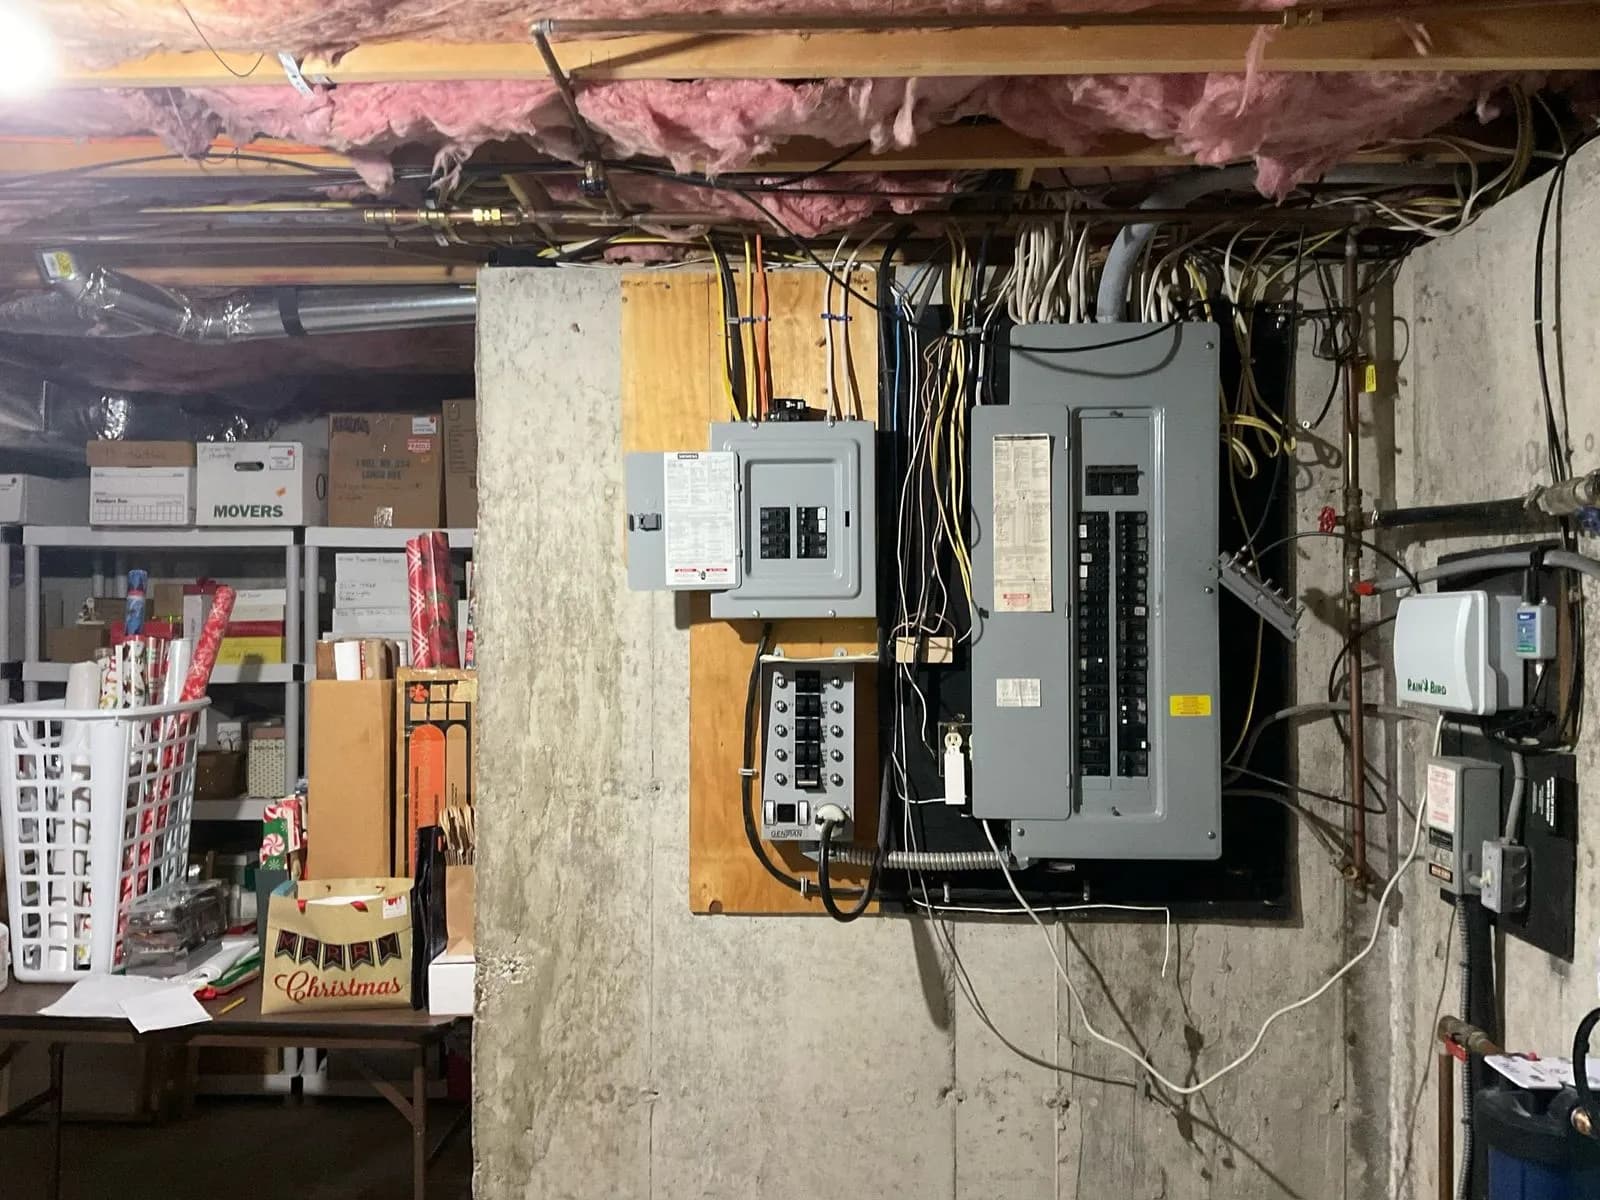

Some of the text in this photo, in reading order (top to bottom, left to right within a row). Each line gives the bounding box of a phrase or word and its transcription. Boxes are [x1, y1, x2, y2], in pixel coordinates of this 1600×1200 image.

[213, 504, 283, 518] MOVERS
[279, 932, 398, 962] MERRY
[274, 970, 401, 1004] Christmas
